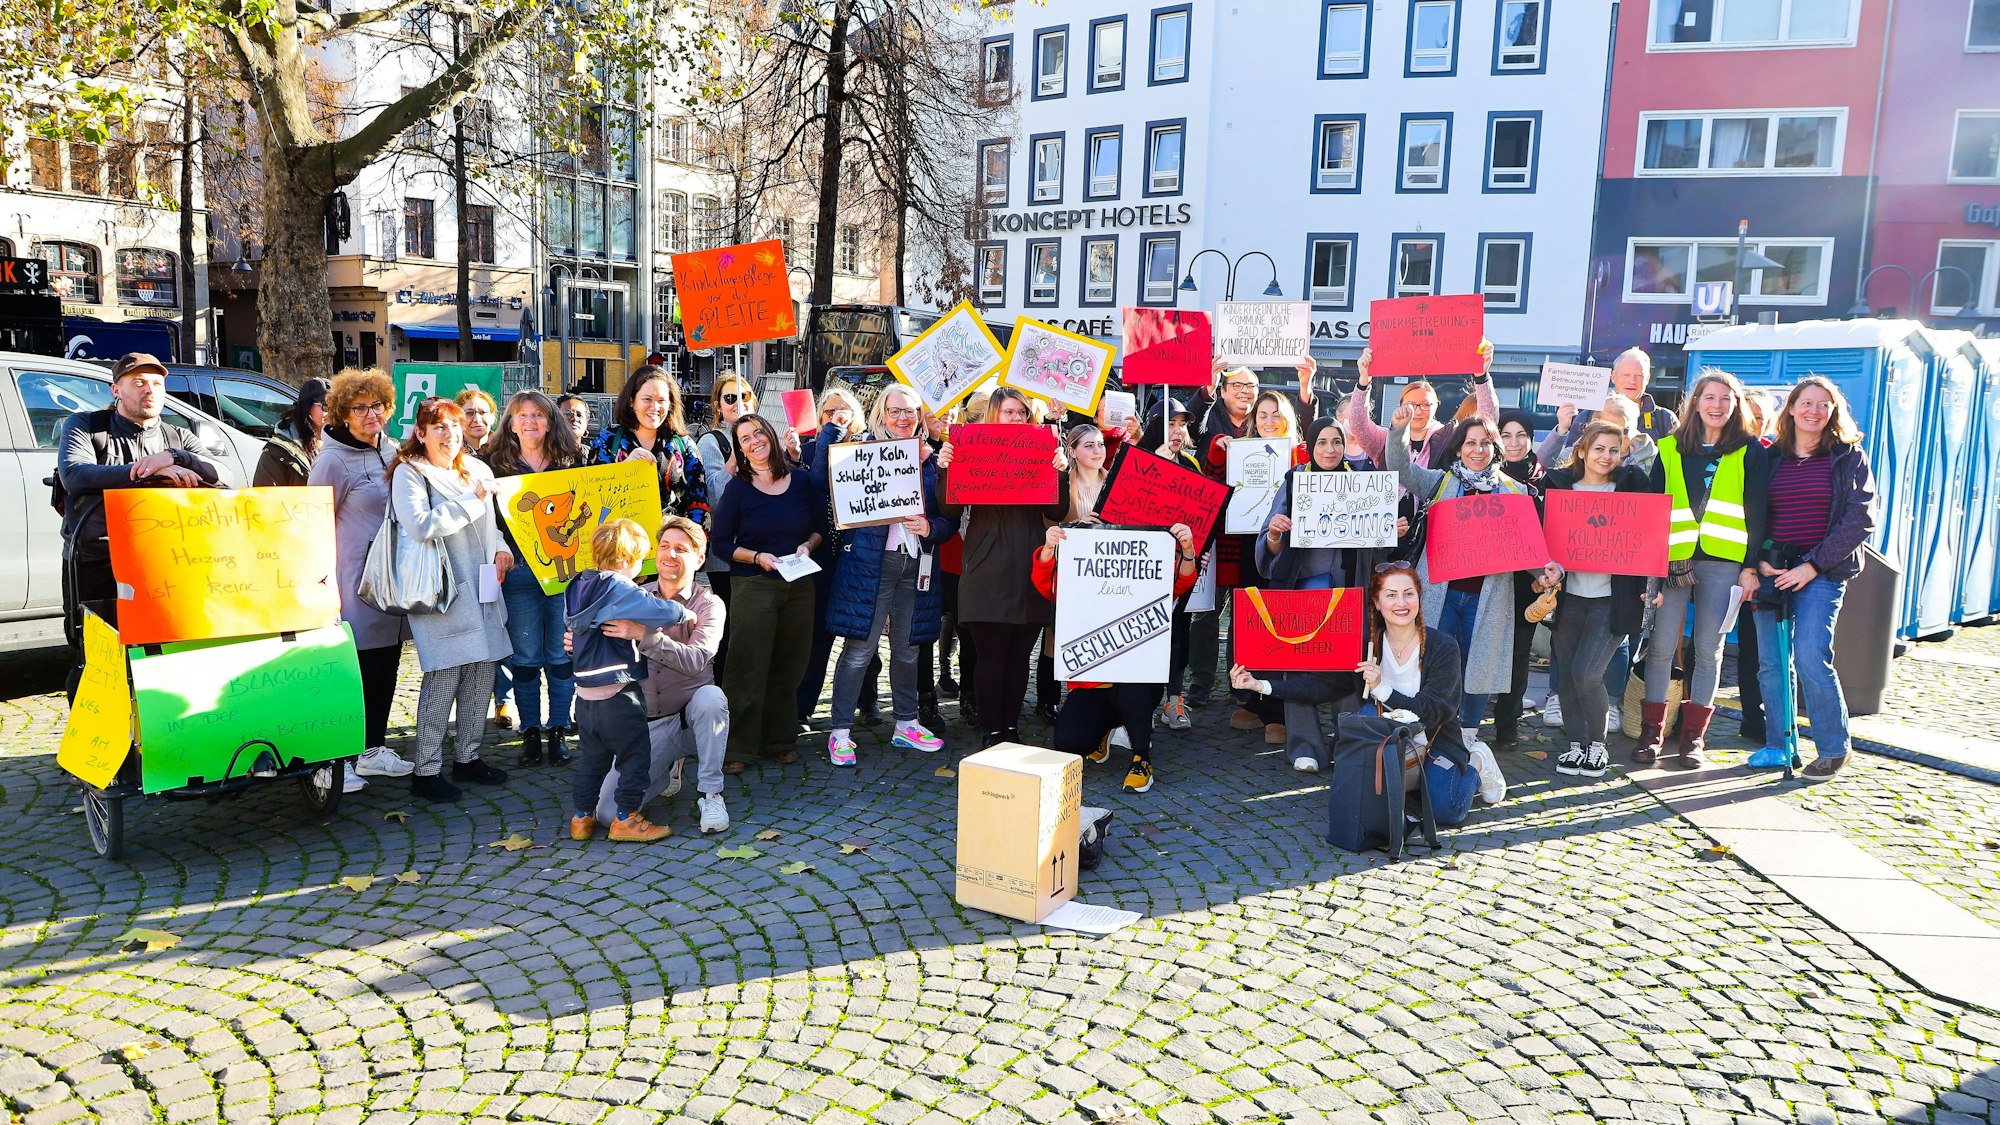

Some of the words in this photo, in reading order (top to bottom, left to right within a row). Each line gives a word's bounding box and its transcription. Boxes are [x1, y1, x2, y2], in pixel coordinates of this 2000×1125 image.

[992, 209, 1095, 232] KONCEPT
[1101, 203, 1191, 227] HOTELS
[1698, 286, 1721, 310] U
[699, 299, 771, 332] PLEITE
[1229, 315, 1265, 325] KOMMUNE
[1271, 315, 1289, 325] KÖLN
[1063, 316, 1114, 336] CAFÉ
[1237, 327, 1259, 338] BALD
[1262, 327, 1282, 338] OHNE
[1650, 323, 1692, 345] HAU
[1691, 328, 1716, 337] Rath
[1548, 368, 1590, 378] Familiennahe
[1551, 376, 1584, 386] Betreuung
[1551, 384, 1596, 394] Energiekosten
[855, 448, 873, 467] Hey
[879, 446, 908, 461] Köln,
[877, 466, 891, 478] Du
[1133, 457, 1161, 479] Wir
[1168, 477, 1203, 496] sind
[864, 480, 887, 496] oder
[1298, 474, 1361, 493] HEIZUNG
[1365, 474, 1393, 493] AUS
[849, 496, 876, 515] hilfst
[1322, 500, 1343, 513] ist
[1456, 495, 1505, 521] SOS
[1560, 498, 1638, 516] INFLATION
[1298, 512, 1395, 538] LÖSUNG
[1567, 528, 1602, 547] KÖLN
[256, 550, 281, 561] aus
[1094, 540, 1148, 557] KINDER
[1567, 547, 1638, 565] VERPENNT
[1073, 557, 1163, 580] TAGESPFLEGE
[146, 580, 177, 600] ist
[1097, 581, 1134, 596] leider
[1062, 602, 1170, 672] GESCHLOSSEN
[1294, 641, 1332, 655] HELFEN
[228, 661, 338, 697] BLACKOUT
[167, 719, 184, 733] IN
[202, 709, 242, 725] DER
